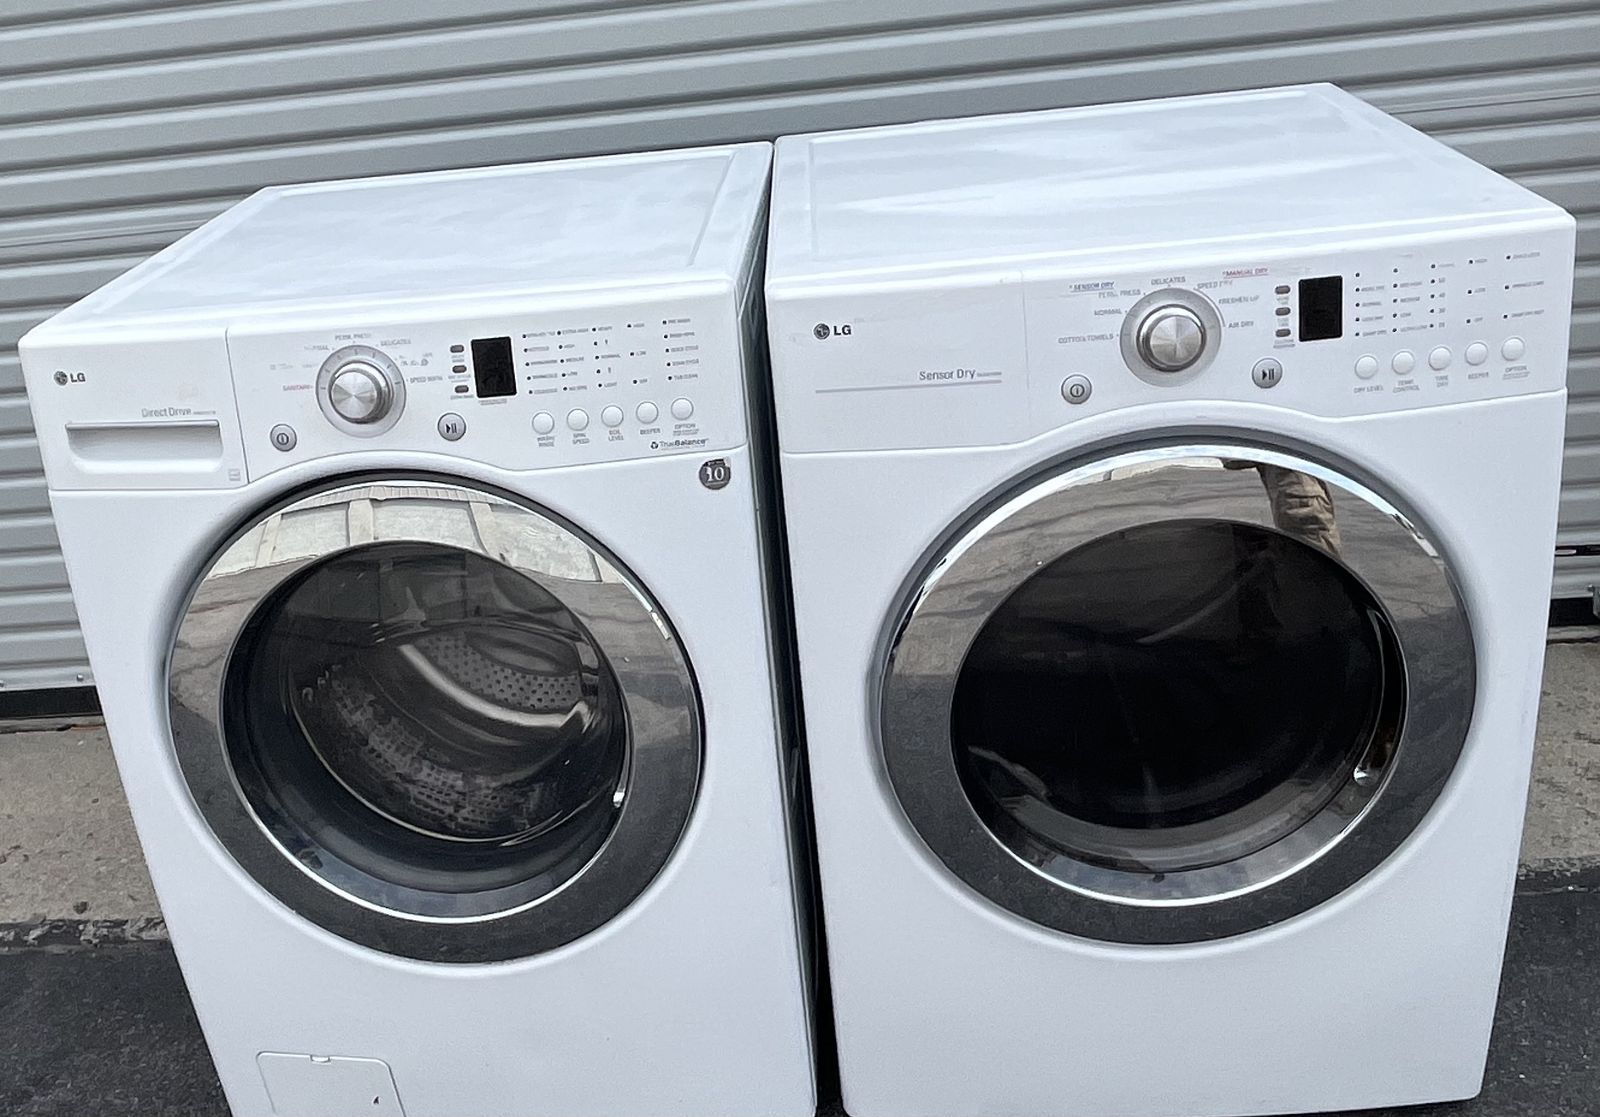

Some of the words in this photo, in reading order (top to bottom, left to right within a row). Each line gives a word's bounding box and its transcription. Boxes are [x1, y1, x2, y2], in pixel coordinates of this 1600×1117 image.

[1150, 276, 1186, 286] DELICATES
[833, 325, 852, 336] LG
[70, 373, 86, 383] LG
[918, 371, 954, 381] Sensor
[956, 368, 976, 380] Dry
[141, 407, 168, 418] Direct
[168, 406, 191, 416] Drive
[704, 466, 725, 482] 10
